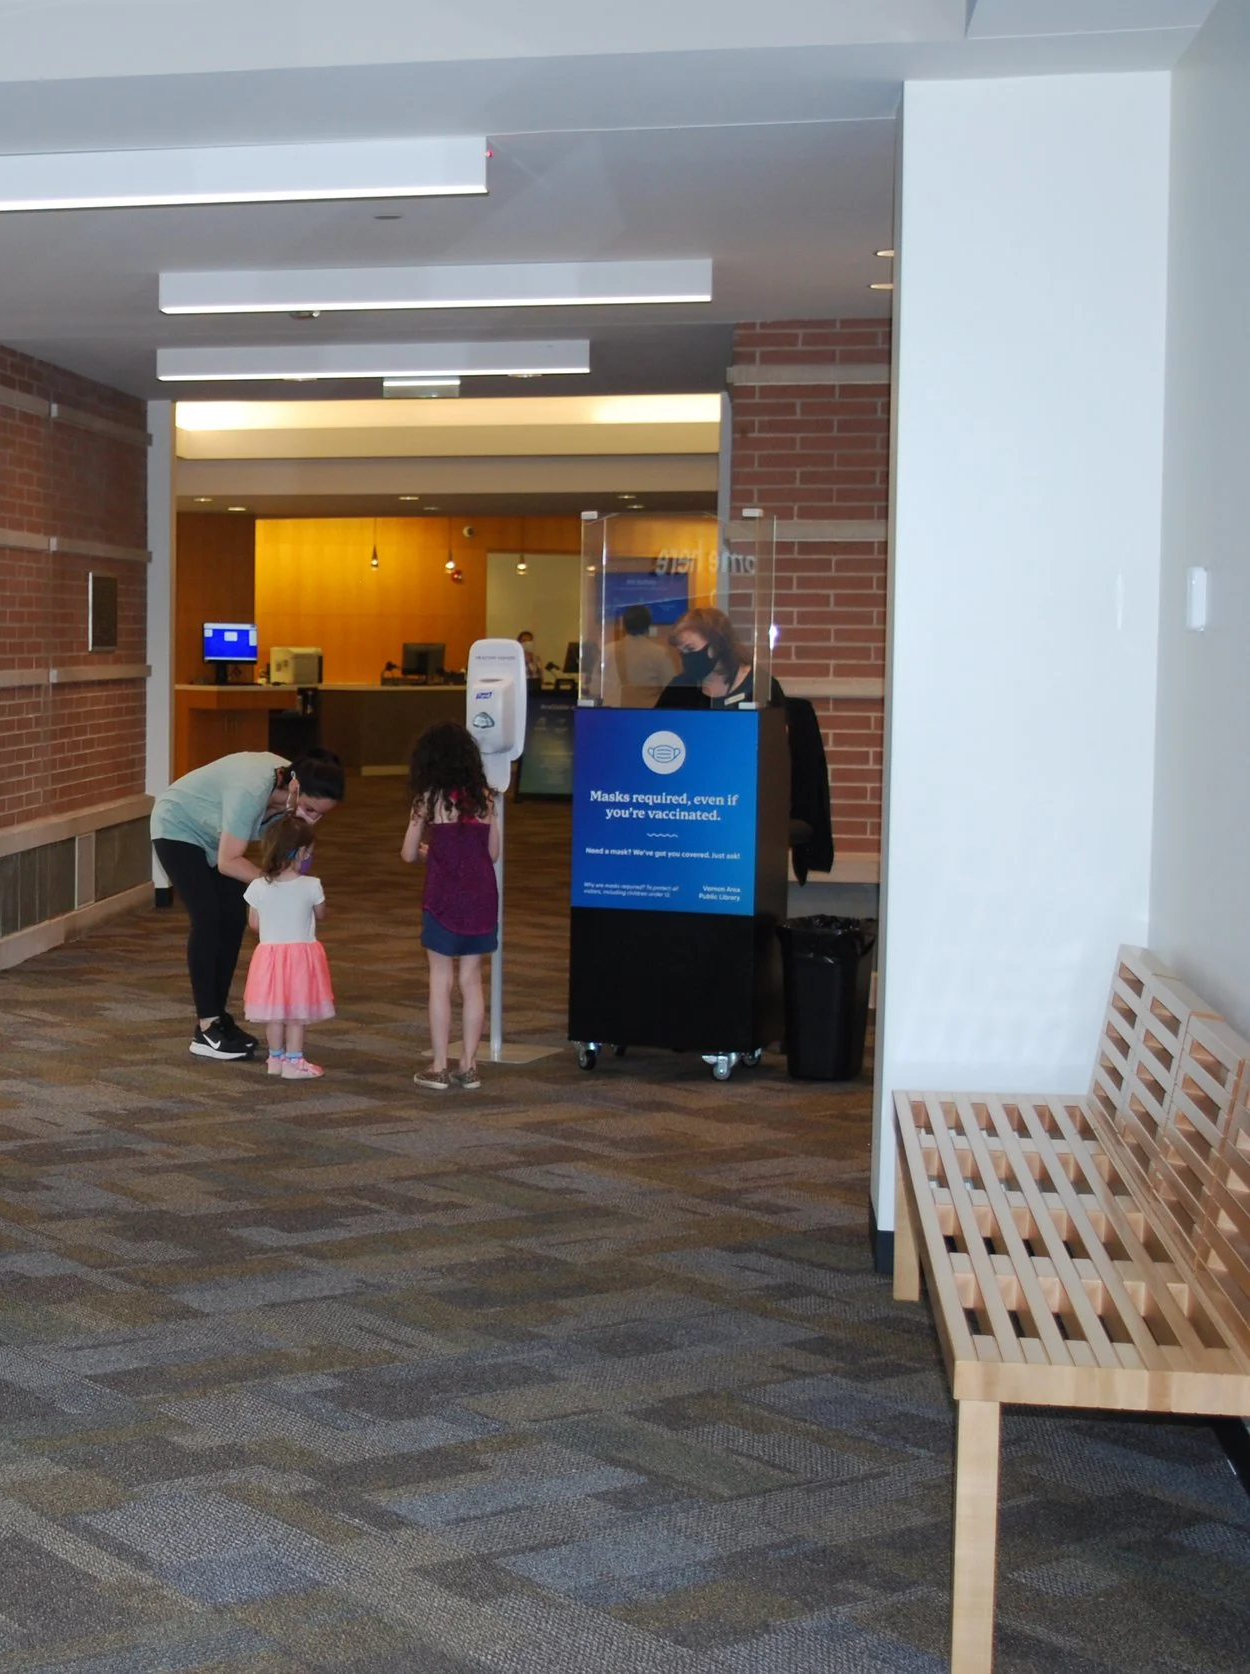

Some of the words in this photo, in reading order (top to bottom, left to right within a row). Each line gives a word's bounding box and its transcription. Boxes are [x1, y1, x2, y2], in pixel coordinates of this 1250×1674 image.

[590, 790, 630, 803] Masks
[632, 792, 691, 806] required,
[693, 795, 724, 806] even
[727, 794, 740, 806] if
[648, 808, 722, 821] vaccinated.
[585, 847, 604, 855] Need
[610, 848, 632, 856] mask?
[633, 848, 654, 857] We've
[654, 850, 667, 858] got
[668, 851, 681, 859] you
[681, 851, 710, 859] covered.
[711, 851, 725, 860] Just
[726, 851, 741, 860] ask!
[702, 884, 726, 892] Vernon
[726, 885, 741, 893] Area
[698, 892, 719, 900] Public
[719, 893, 741, 903] Library
